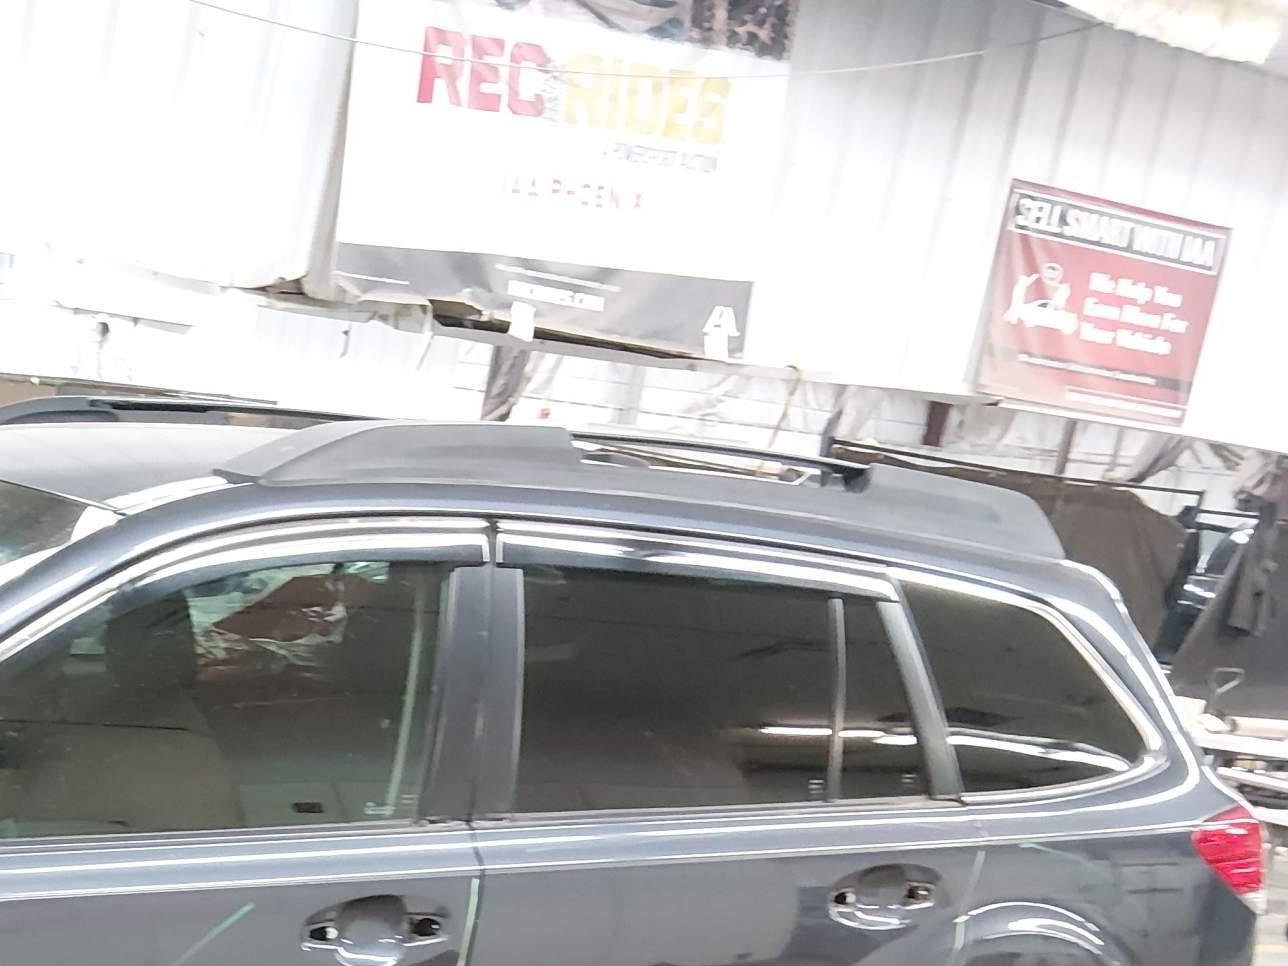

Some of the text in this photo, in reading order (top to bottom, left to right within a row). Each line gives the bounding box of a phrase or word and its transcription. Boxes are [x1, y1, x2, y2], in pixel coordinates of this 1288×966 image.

[416, 24, 551, 118] REC
[565, 54, 731, 145] RIDES
[1014, 198, 1062, 233] SELL
[1063, 208, 1134, 248] SMART
